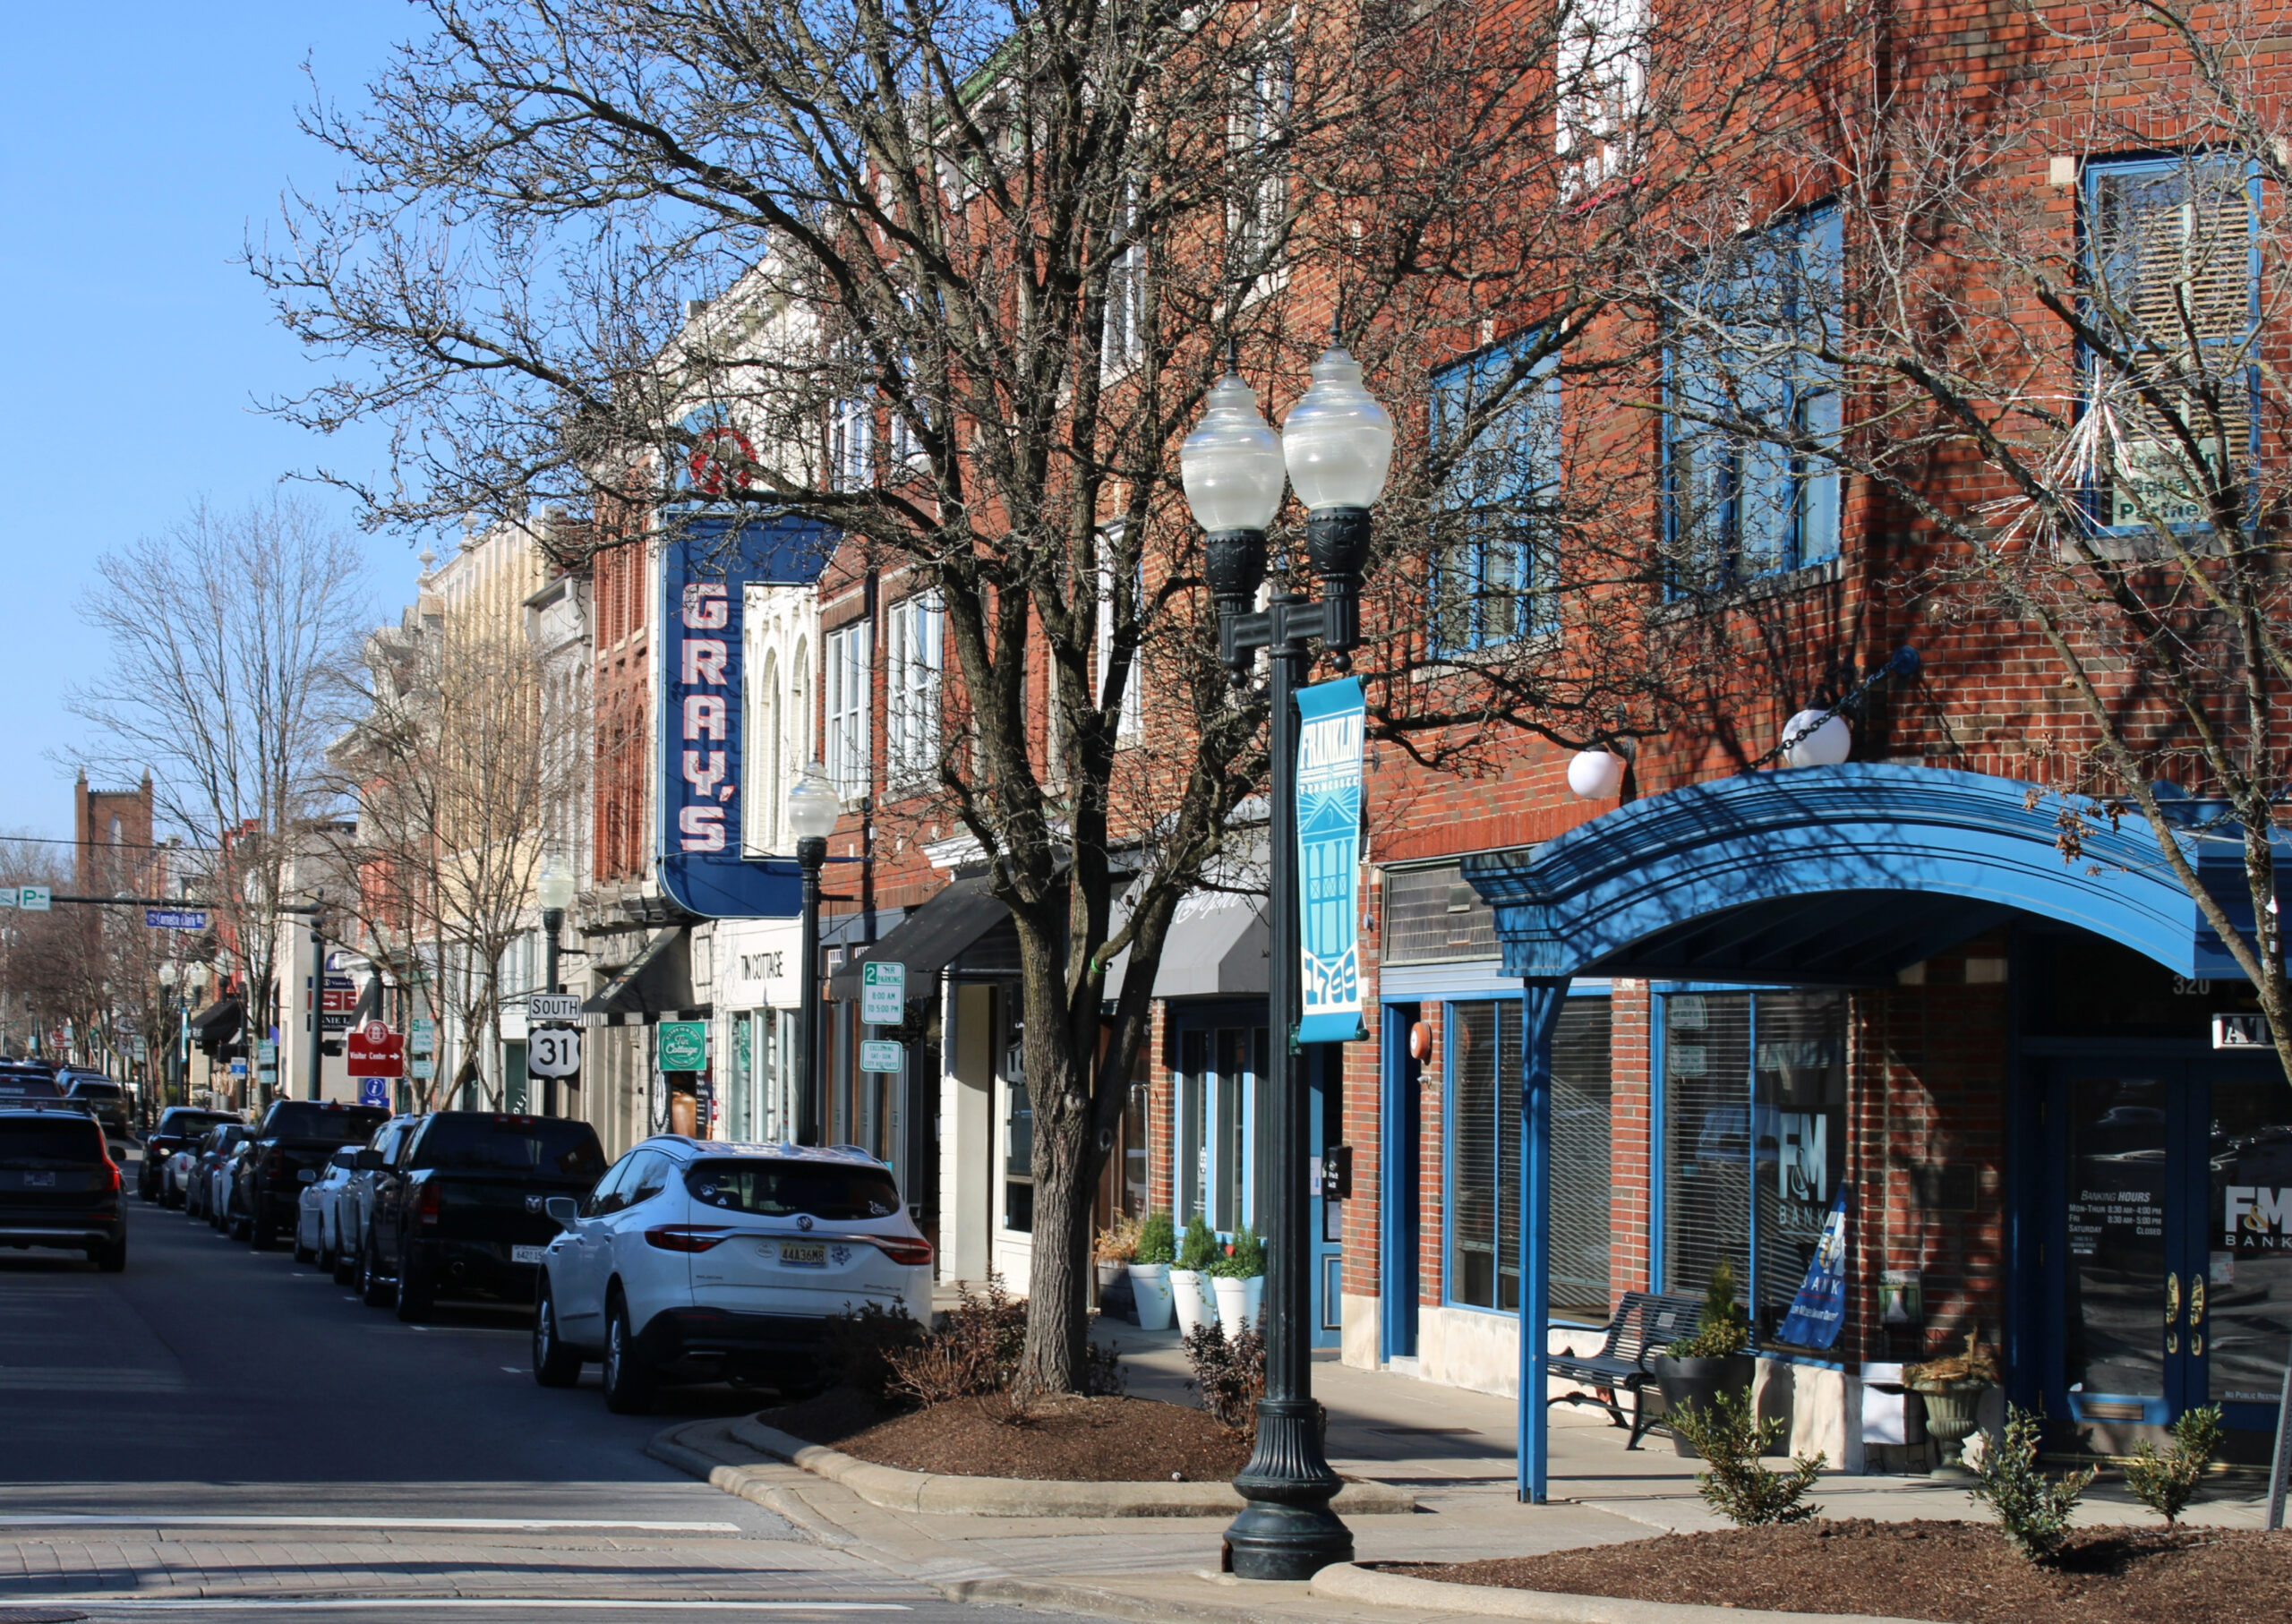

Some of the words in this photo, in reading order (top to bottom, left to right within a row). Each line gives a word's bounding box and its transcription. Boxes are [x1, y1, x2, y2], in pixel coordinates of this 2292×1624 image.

[680, 584, 734, 850] GRAY'S
[1300, 714, 1362, 770] FRANKLIN
[1299, 776, 1359, 795] TENNESSEE
[740, 954, 751, 980] TIN
[753, 951, 783, 980] COTTAGE
[866, 967, 876, 983] 2
[877, 975, 902, 984] PARKING
[1304, 950, 1357, 1004] 1799
[2173, 974, 2211, 995] 320
[887, 992, 895, 1000] AM
[532, 999, 577, 1014] SOUTH
[890, 1005, 899, 1013] PM
[350, 1051, 367, 1060] Visitor
[369, 1051, 387, 1060] Center
[539, 1038, 568, 1065] 31
[665, 1043, 698, 1056] Cottage
[1779, 1112, 1827, 1202] F&M
[2081, 1190, 2117, 1201] BANKING
[2117, 1192, 2151, 1203] HOURS
[1779, 1205, 1826, 1227] BANK
[2225, 1235, 2292, 1248] BANK
